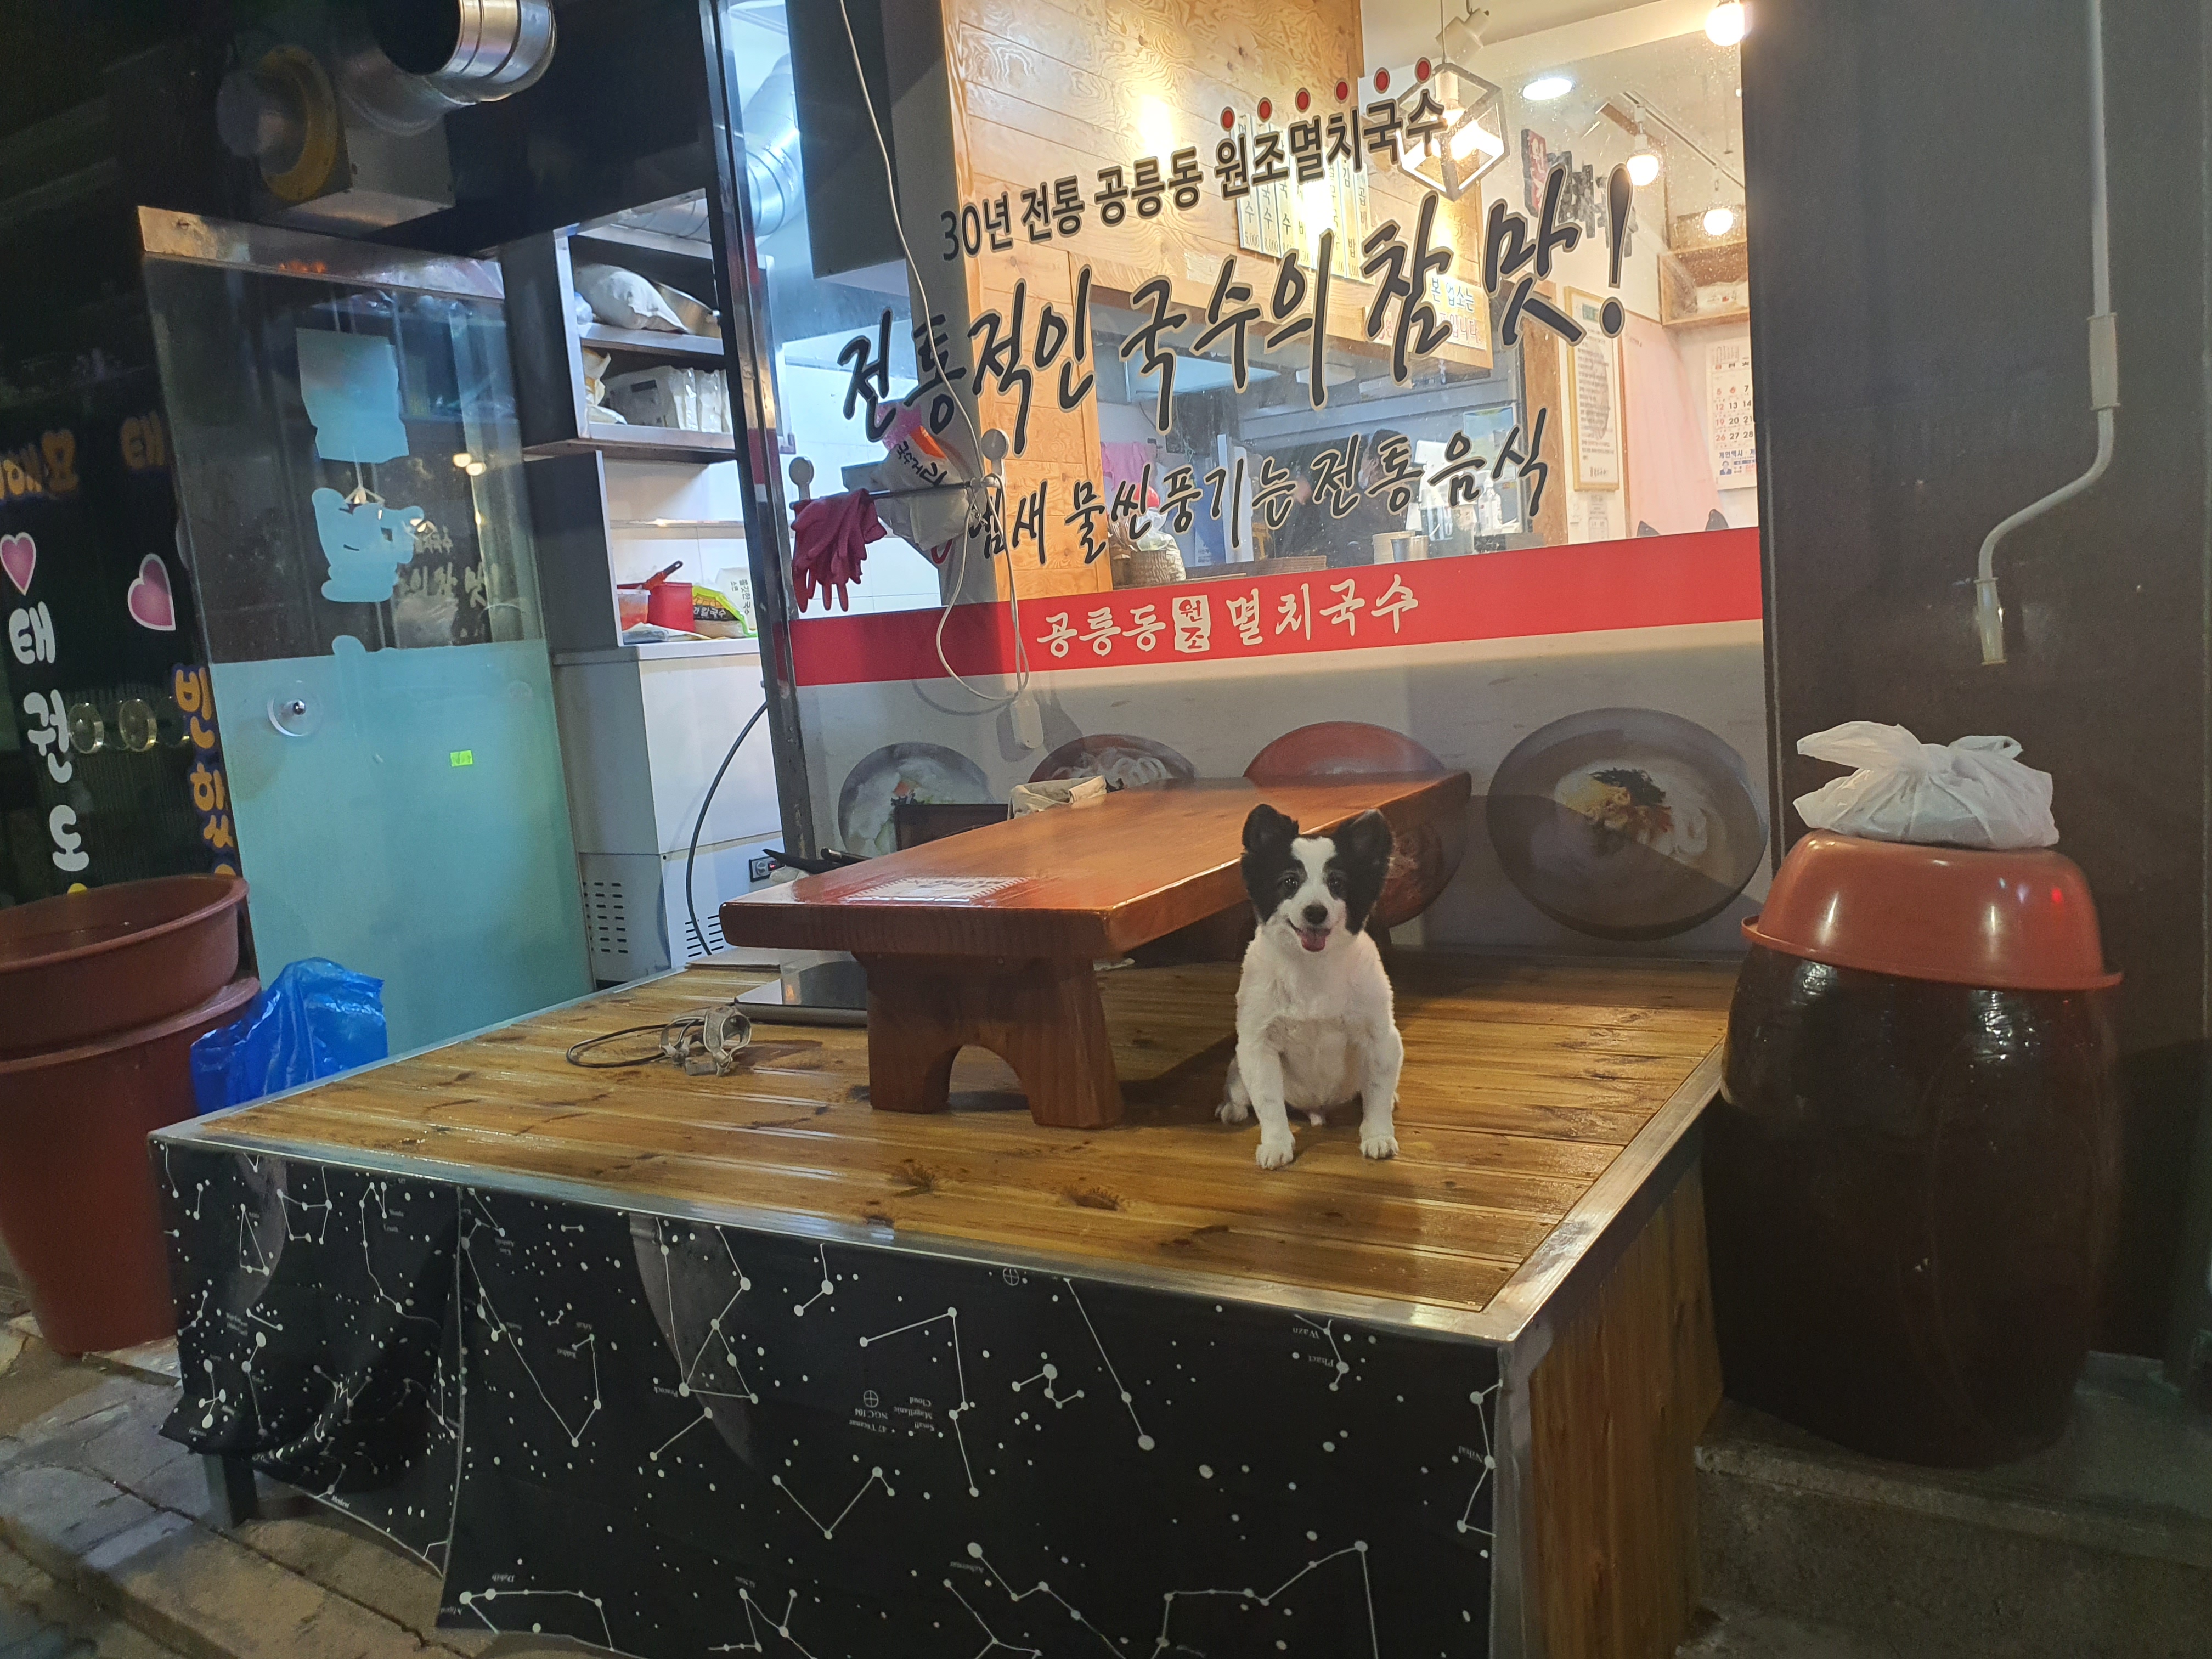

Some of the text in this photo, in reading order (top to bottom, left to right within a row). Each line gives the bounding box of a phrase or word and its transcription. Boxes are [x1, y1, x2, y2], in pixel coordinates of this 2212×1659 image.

[940, 88, 1448, 262] 30년 전통 공릉동 원조멸치국수
[837, 264, 1095, 458] 전통적인
[1119, 228, 1335, 436] 국수의
[1360, 190, 1454, 387] 참
[1036, 573, 1419, 658] 공릉동 원조 멸치국수
[1292, 1327, 1320, 1340] Wazn
[909, 1396, 932, 1407] Cloud
[854, 1407, 888, 1420] NGC 104
[893, 1406, 933, 1420] Magellanic
[913, 1421, 935, 1431] Small
